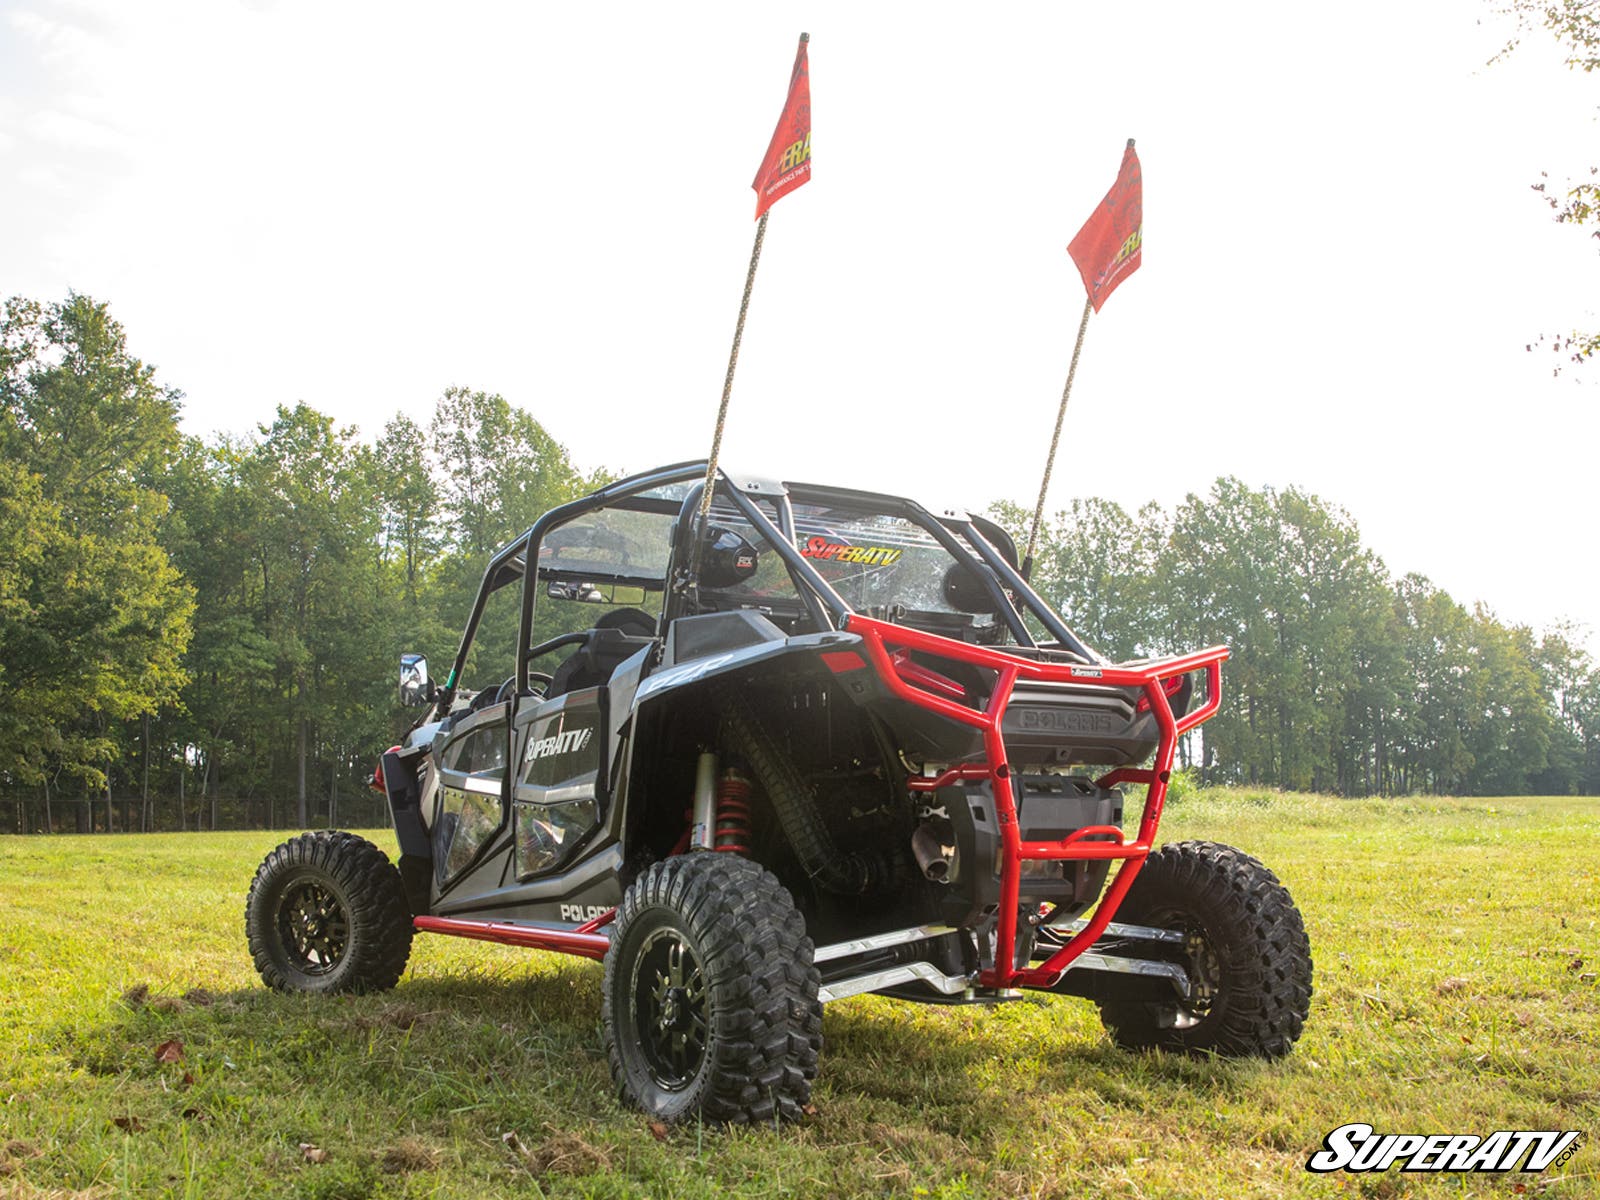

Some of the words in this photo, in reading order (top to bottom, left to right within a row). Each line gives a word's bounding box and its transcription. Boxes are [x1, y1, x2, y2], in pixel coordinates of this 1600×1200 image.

[800, 537, 901, 566] SUPERATV
[1021, 710, 1112, 733] POLARIS
[525, 728, 589, 763] SUPERATV
